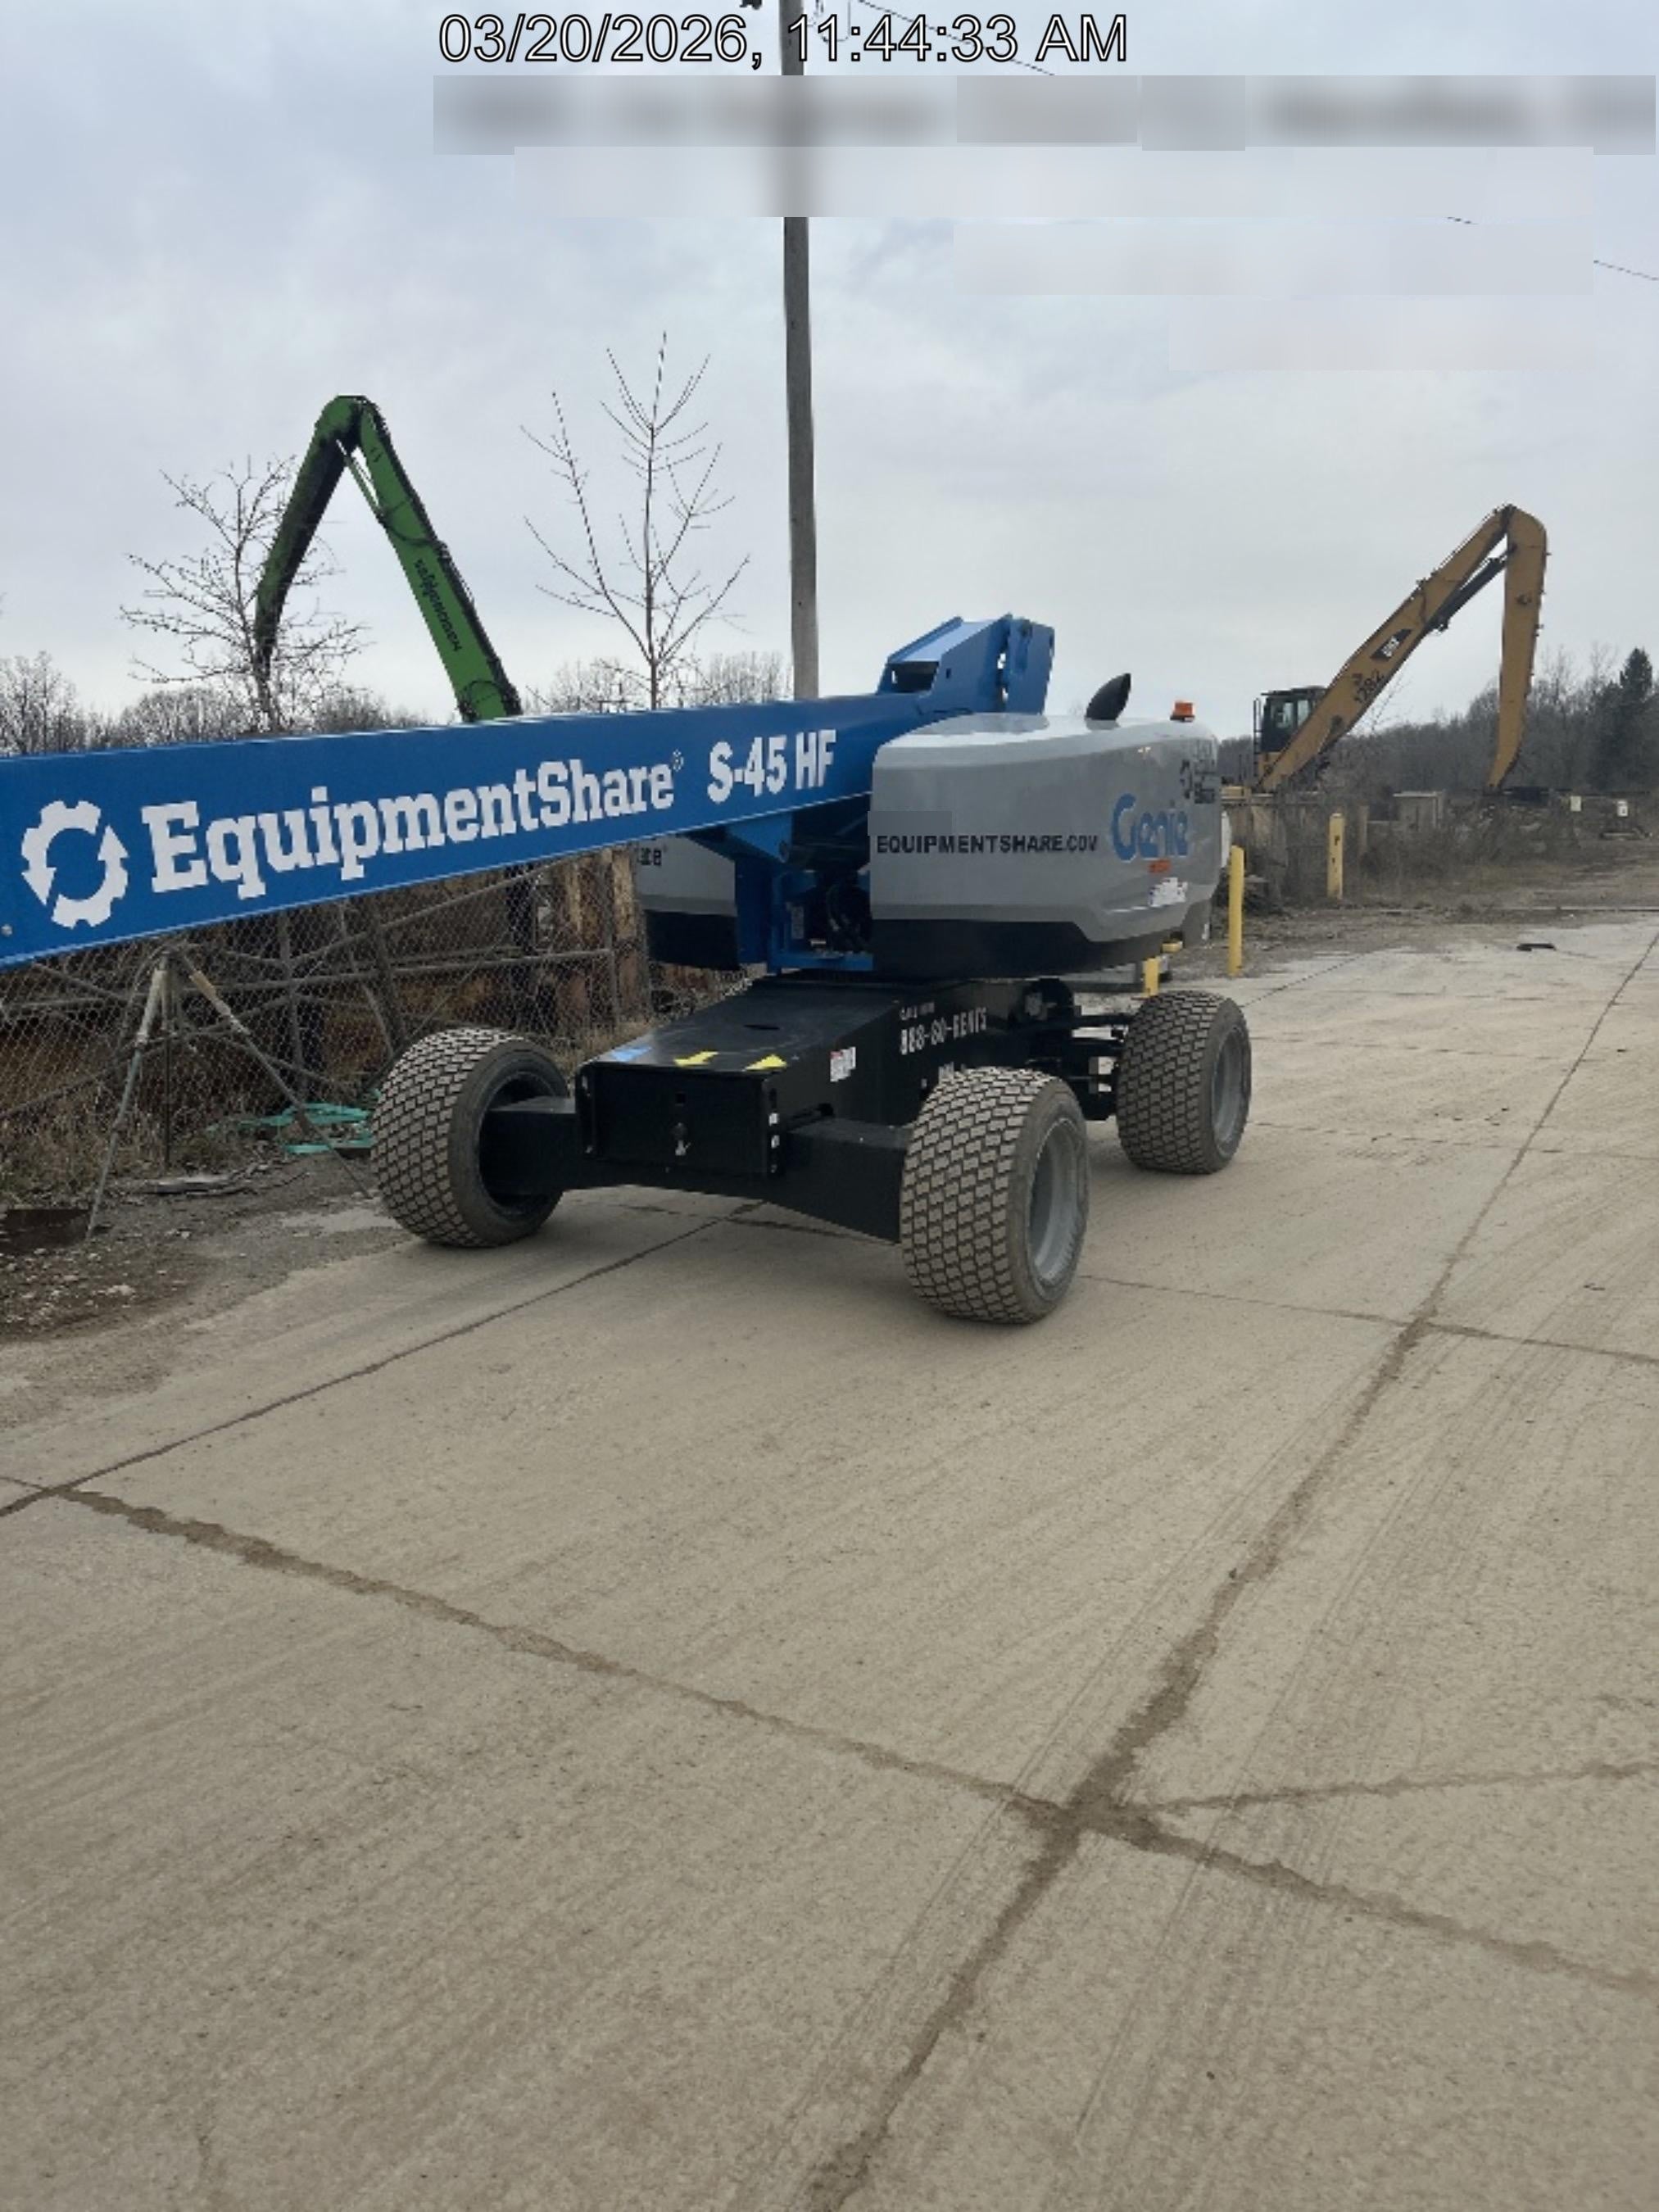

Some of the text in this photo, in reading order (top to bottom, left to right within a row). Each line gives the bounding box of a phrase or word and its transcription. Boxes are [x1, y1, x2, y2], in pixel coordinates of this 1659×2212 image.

[707, 729, 836, 805] S-45 HF
[141, 760, 675, 900] EquipmentShare
[1111, 792, 1189, 862] Genie
